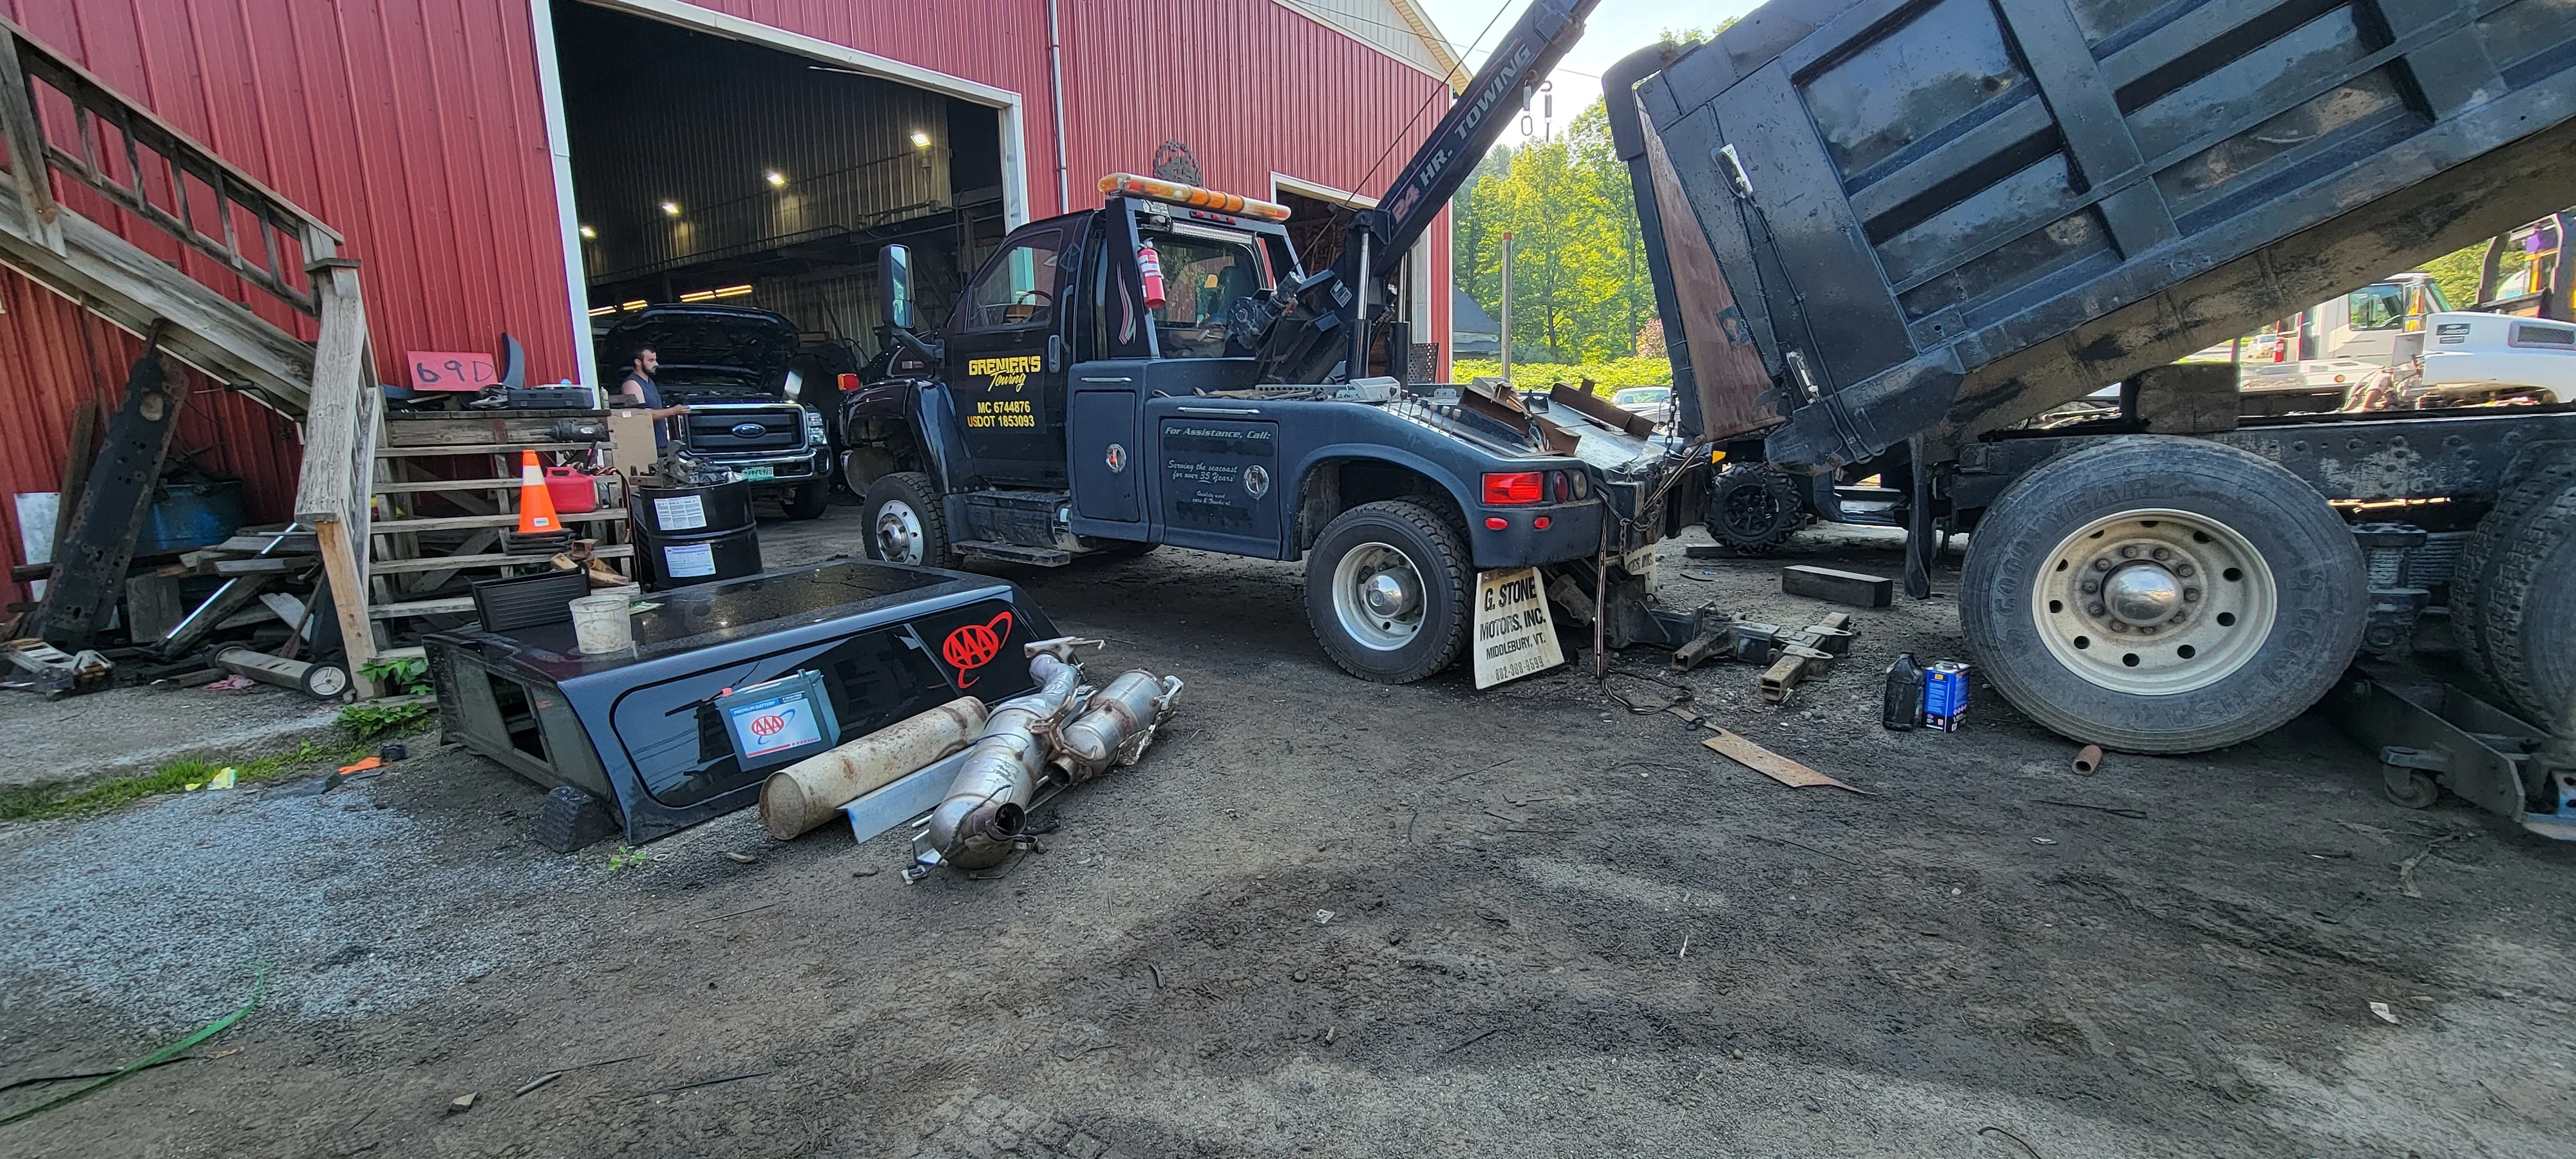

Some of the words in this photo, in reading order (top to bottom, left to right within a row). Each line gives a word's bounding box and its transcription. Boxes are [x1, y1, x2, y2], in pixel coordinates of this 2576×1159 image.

[1391, 184, 1420, 224] 24
[1419, 148, 1454, 188] HR.
[1454, 43, 1532, 140] TOWING
[969, 355, 1041, 375] GRENIER'S
[987, 370, 1027, 392] Towing
[977, 402, 992, 413] MC
[993, 400, 1030, 413] 6744876
[967, 415, 996, 427] USDOT
[998, 415, 1035, 427] 1853093
[1164, 426, 1182, 435] For
[1182, 428, 1244, 439] Assistance,
[1247, 430, 1272, 440] Call:
[1168, 460, 1194, 472] Serving
[1196, 462, 1206, 471] the
[1208, 465, 1238, 473] seacoast
[1172, 470, 1183, 480] for
[1199, 471, 1211, 480] 35
[1211, 472, 1234, 483] Years
[1197, 490, 1214, 498] Quality
[1484, 587, 1495, 612] G.
[1498, 576, 1537, 608] STONE
[1479, 613, 1523, 642] MOTORS,
[1523, 607, 1547, 628] INC.
[944, 625, 998, 668] AAA
[1486, 635, 1533, 661] MIDDLEBURY,
[1532, 632, 1546, 645] VT.
[1495, 655, 1545, 681] 802-388-9599
[734, 705, 755, 715] PREMIUM
[755, 701, 776, 710] BATTERY
[752, 715, 784, 735] AAA
